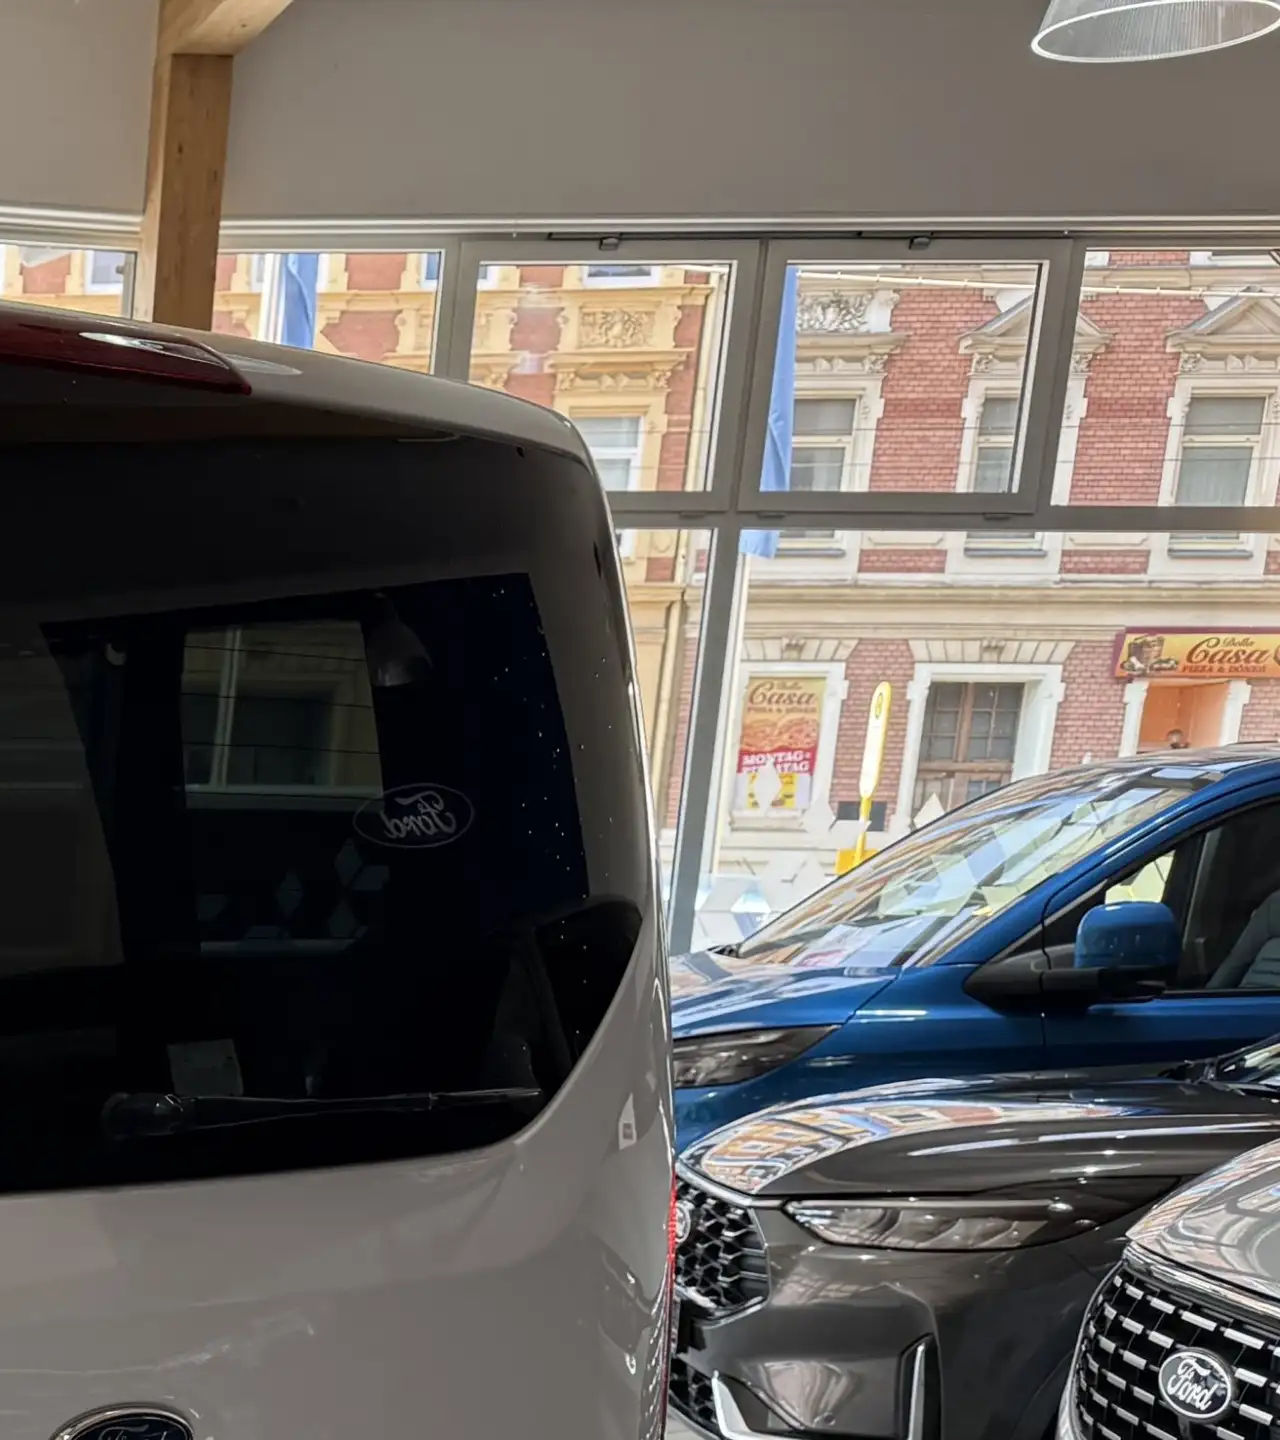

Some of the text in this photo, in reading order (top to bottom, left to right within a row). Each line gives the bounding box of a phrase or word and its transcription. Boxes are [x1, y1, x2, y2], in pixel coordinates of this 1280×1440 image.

[1186, 637, 1270, 664] Casa
[749, 681, 818, 705] Casa
[1167, 1358, 1214, 1411] Ford
